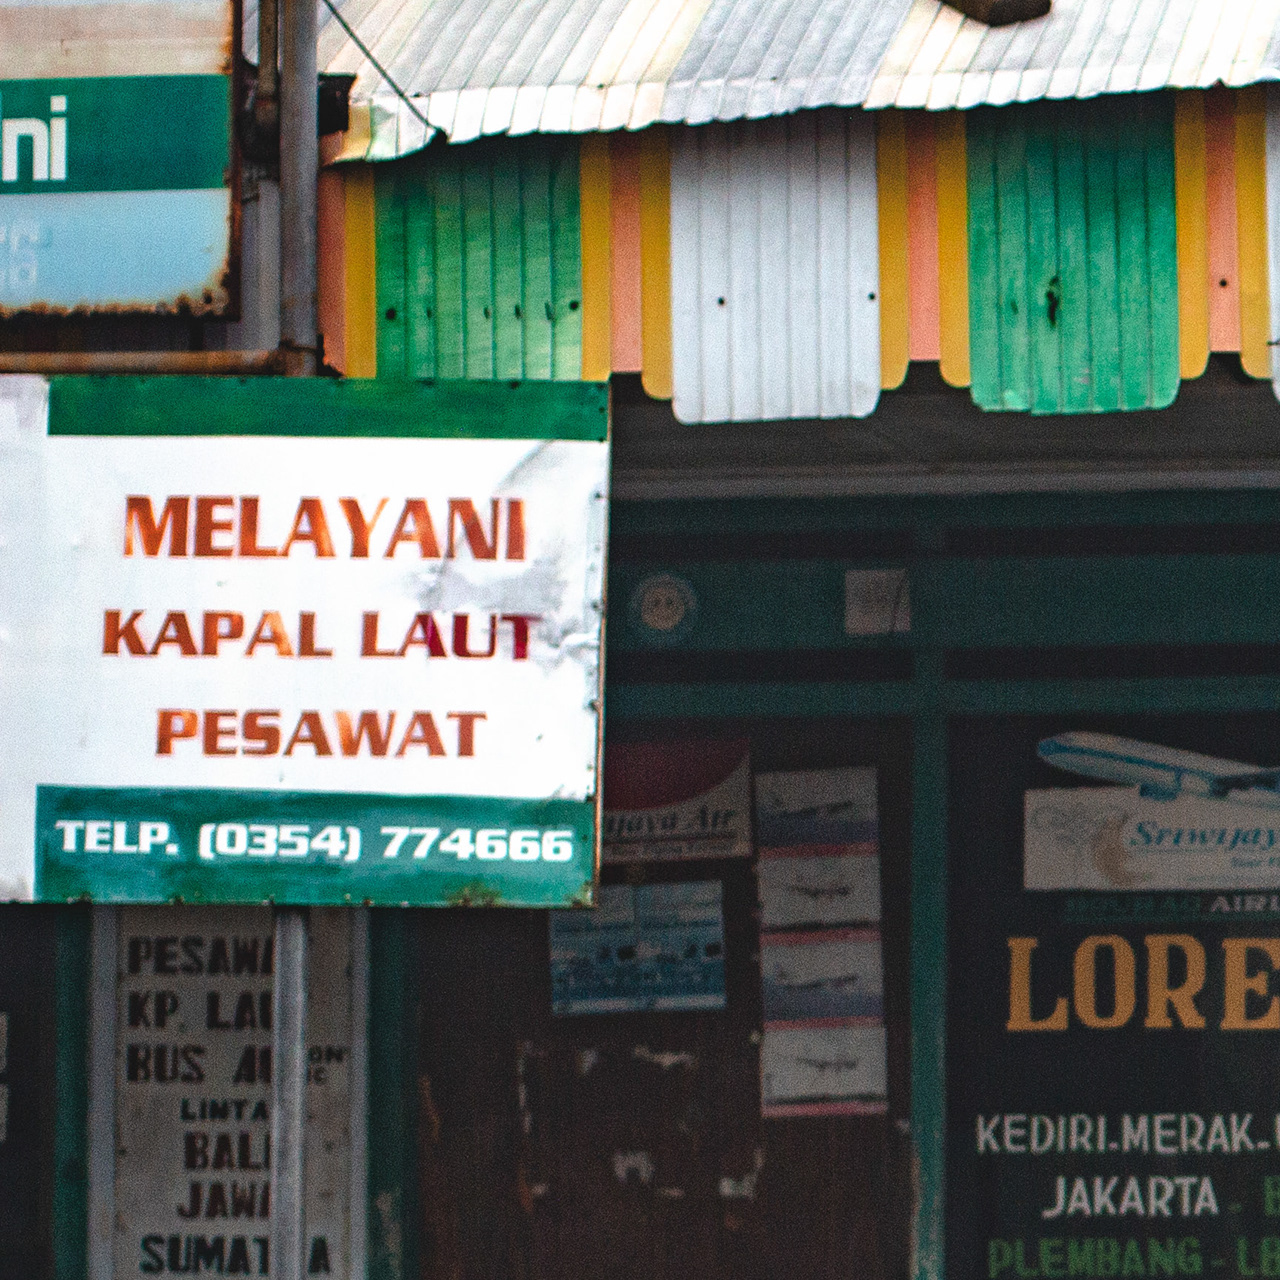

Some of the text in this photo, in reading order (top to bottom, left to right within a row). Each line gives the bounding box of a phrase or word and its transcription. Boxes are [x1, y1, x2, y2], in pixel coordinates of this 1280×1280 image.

[123, 494, 527, 560] MELAYANI
[102, 609, 542, 660] KAPAL LAUT
[155, 709, 487, 757] PESAWAT
[56, 820, 179, 854] TELP.
[198, 822, 362, 862] (0354)
[381, 826, 574, 861] 774666
[126, 1043, 206, 1084] BUS
[1042, 1174, 1219, 1219] JAKARTA
[140, 1233, 331, 1276] SUMATA
[988, 1236, 1202, 1279] PLEMBANG
